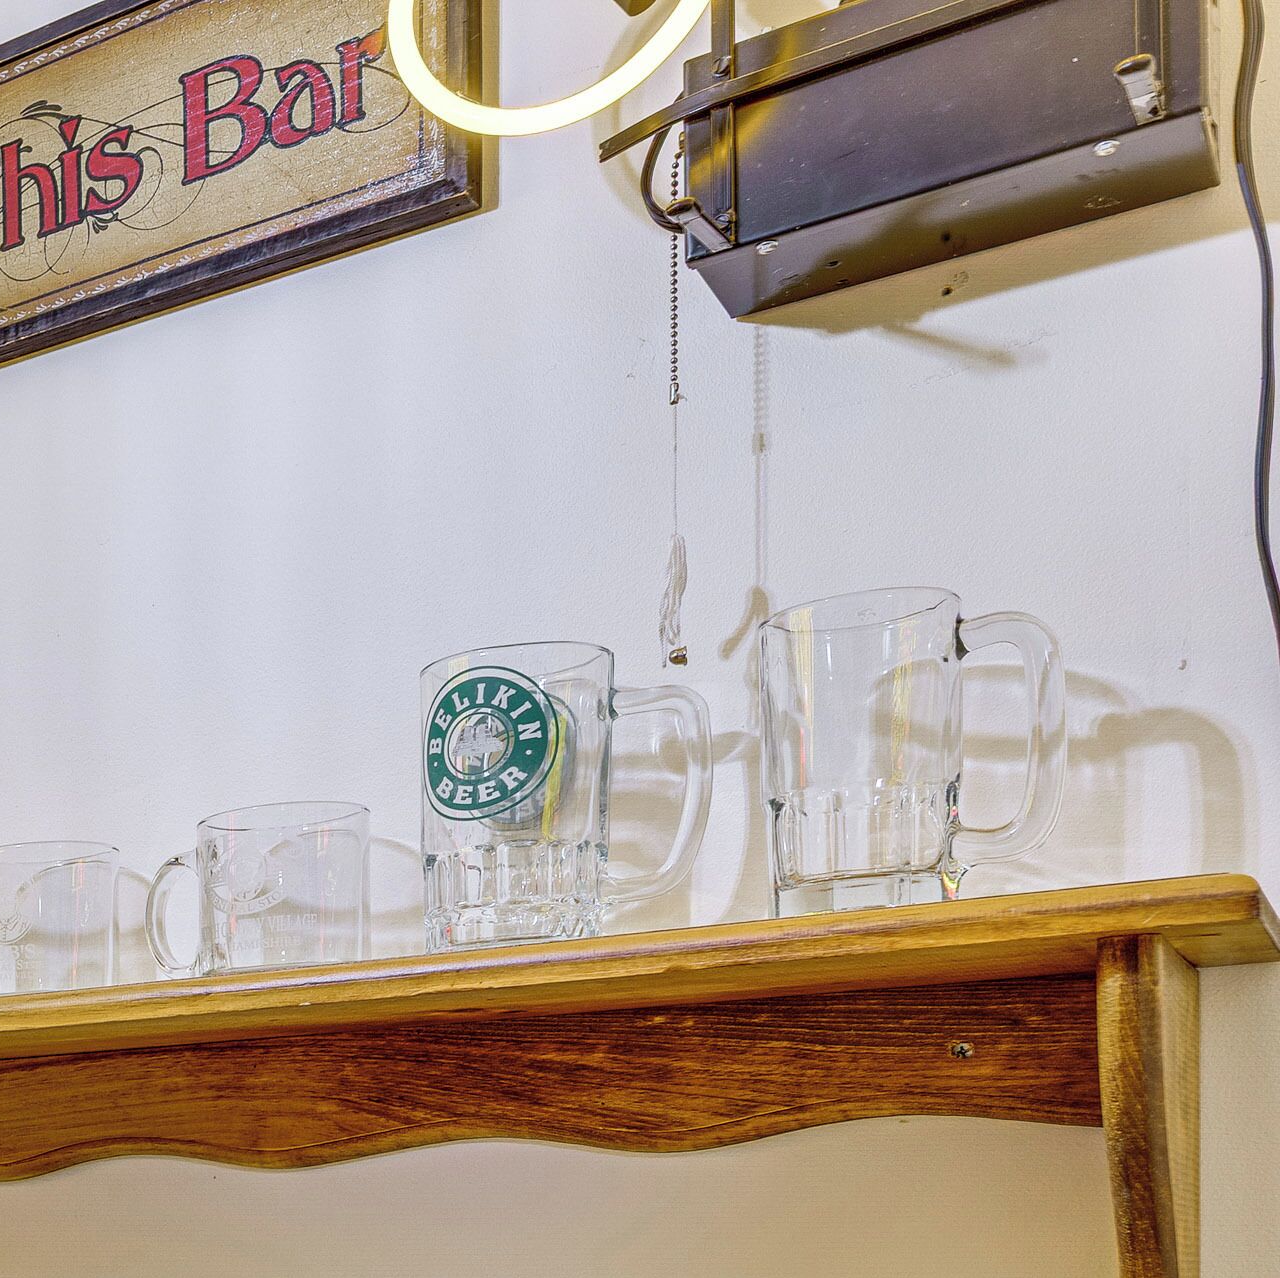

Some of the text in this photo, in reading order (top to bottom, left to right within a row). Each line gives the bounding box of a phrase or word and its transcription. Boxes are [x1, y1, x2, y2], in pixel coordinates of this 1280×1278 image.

[178, 25, 388, 187] Bar
[429, 682, 543, 756] BELIKIN
[436, 765, 528, 805] BEER
